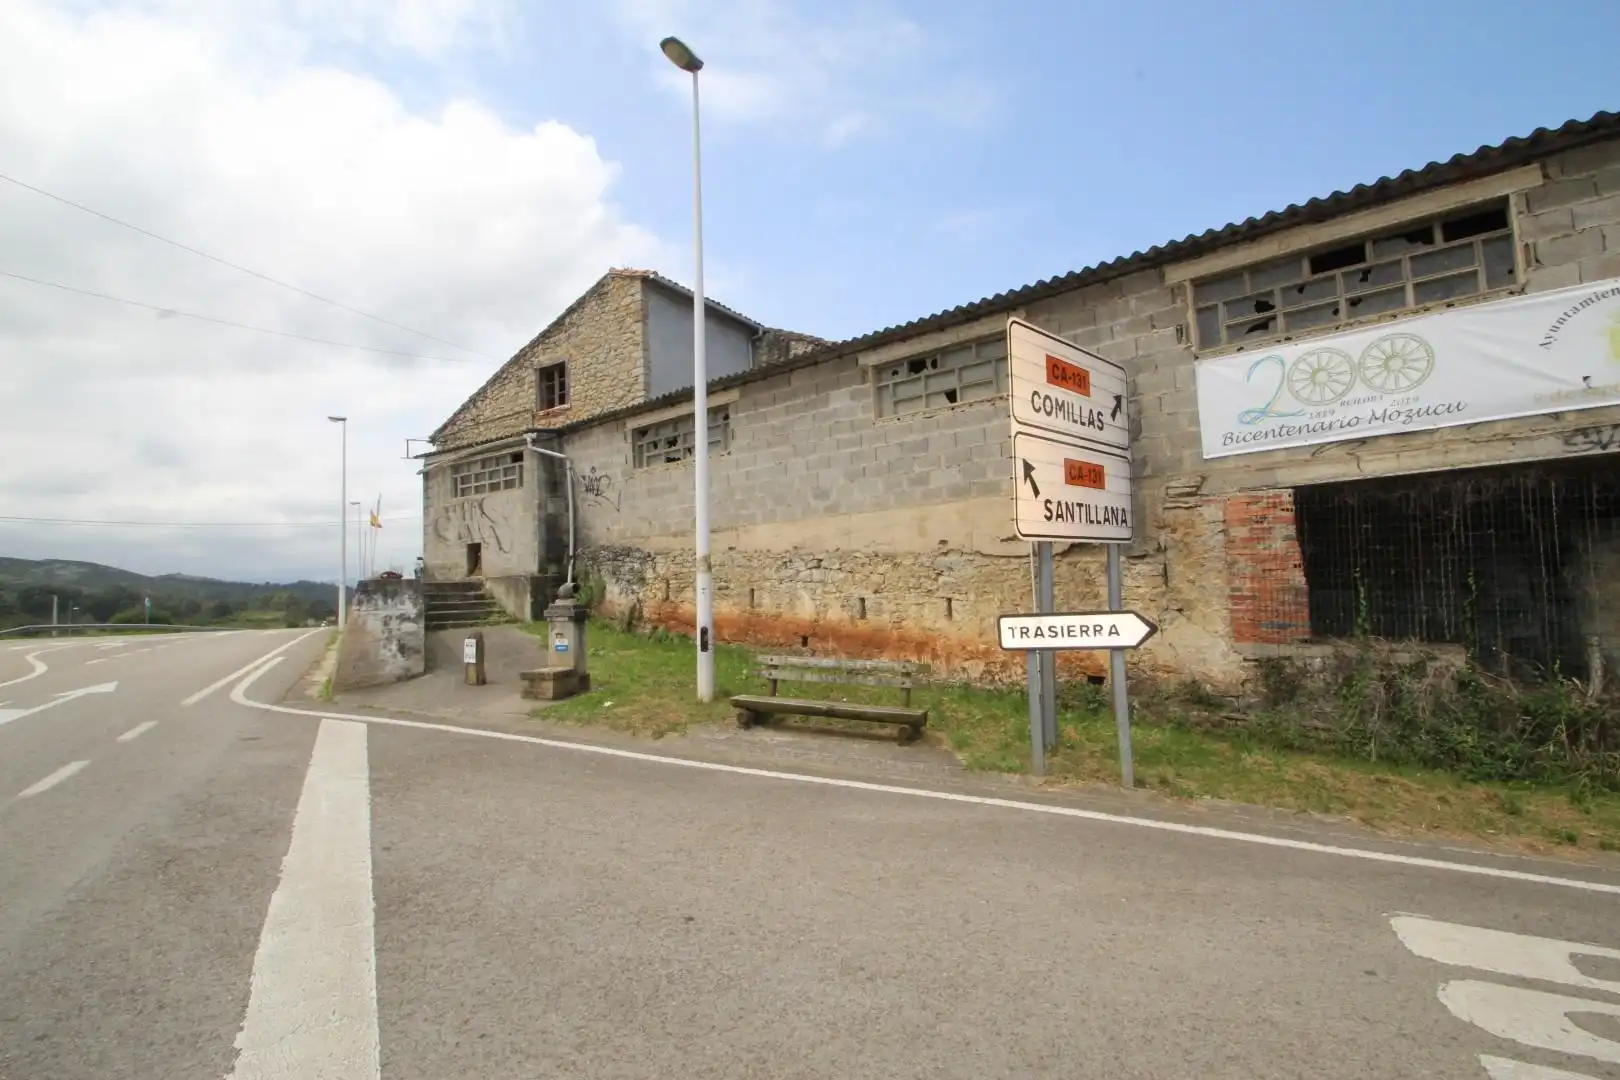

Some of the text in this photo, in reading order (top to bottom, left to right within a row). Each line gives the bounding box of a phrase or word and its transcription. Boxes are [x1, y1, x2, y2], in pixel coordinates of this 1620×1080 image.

[1051, 363, 1088, 389] CA-131
[1030, 389, 1105, 431] COMILLAS
[1222, 401, 1469, 446] Bicentenario Mozucu
[1068, 465, 1103, 485] CA-131
[1043, 498, 1129, 527] SANTILLANA
[1007, 623, 1121, 639] TRASIERRA
